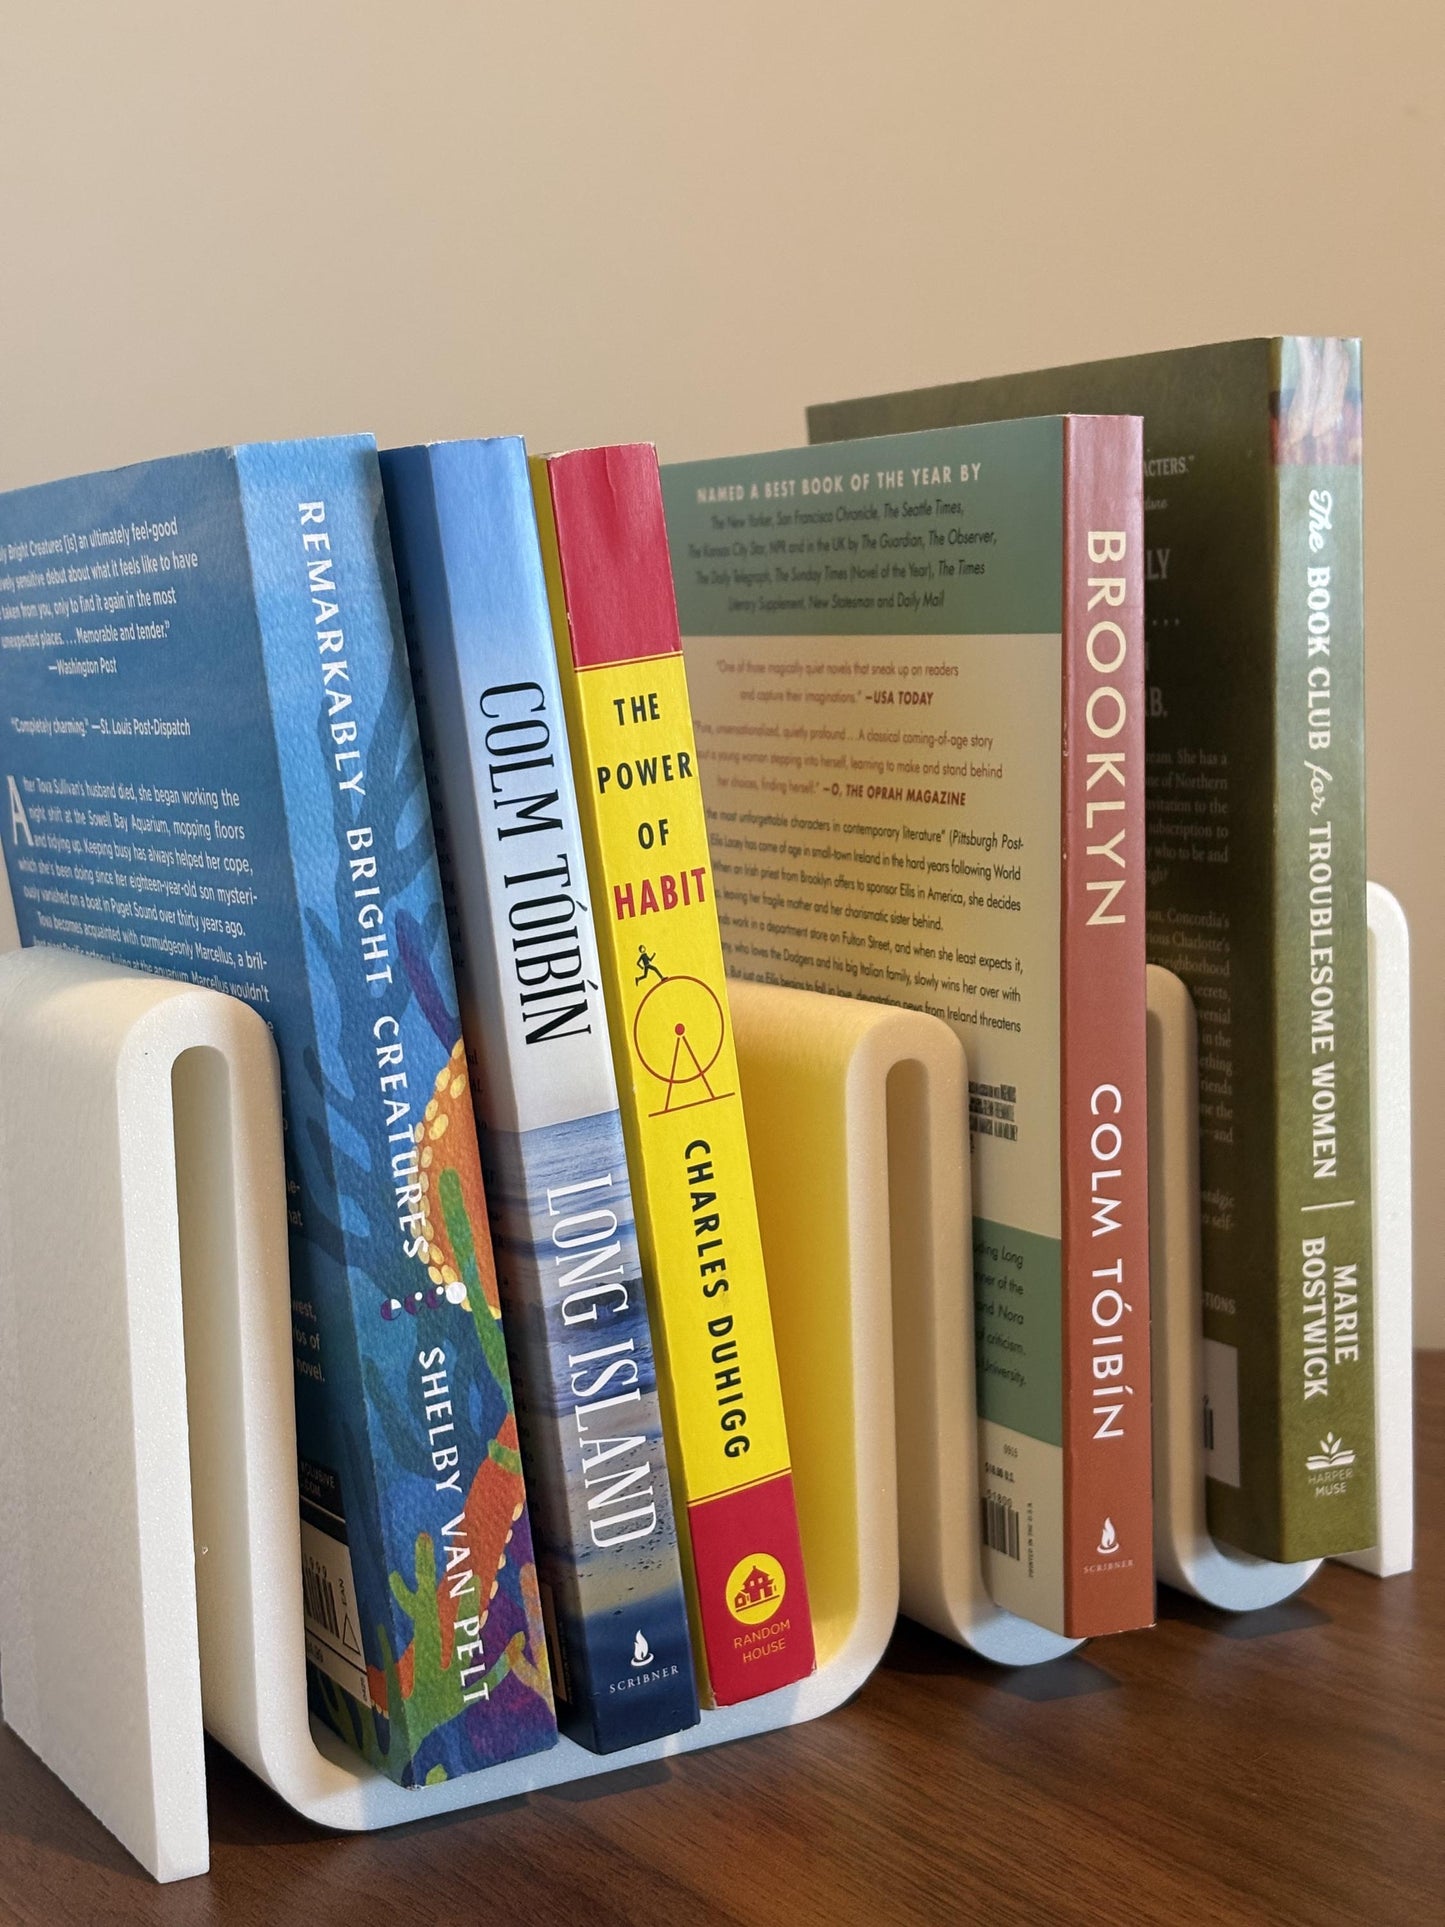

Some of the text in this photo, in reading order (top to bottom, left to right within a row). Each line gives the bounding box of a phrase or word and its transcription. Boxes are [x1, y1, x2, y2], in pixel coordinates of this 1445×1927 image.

[697, 463, 981, 503] NAMED A BEST BOOK OF THE YEAR BY
[884, 499, 964, 518] The Seattle Times,
[30, 516, 178, 556] Creatures [is] an ultimately feel-good
[862, 528, 997, 551] The Guardian, The Observer,
[68, 550, 198, 582] about what it feels like to have
[938, 560, 985, 576] The Times
[79, 584, 177, 613] find it again in the most
[897, 589, 944, 611] Daily Mail
[76, 620, 171, 644] Memorable and tender.”
[100, 656, 117, 674] Post
[925, 663, 959, 677] readers
[613, 693, 660, 725] THE
[897, 691, 934, 706] TODAY
[113, 719, 132, 736] Louis
[133, 719, 191, 738] Post-Dispatch
[902, 731, 993, 751] coming-of-age story
[1085, 531, 1127, 926] BROOKLYN
[597, 751, 693, 793] POWER
[923, 761, 1003, 778] and stand behind
[85, 781, 240, 809] husband died, she began working the
[846, 785, 863, 798] THE
[867, 787, 902, 802] OPRAH
[906, 789, 966, 806] MAGAZINE
[114, 812, 245, 841] Bay Aquarium, mopping floors
[638, 819, 669, 849] OF
[843, 823, 1023, 852] contemporary literature” (Pittsburgh Post-
[1304, 490, 1337, 1180] The BOOK CLUB for TROUBLESOME WOMEN
[116, 844, 253, 876] busy has always helped her cope,
[479, 681, 598, 1045] COLM TÓIBÍN
[853, 849, 1020, 882] Ireland following World
[116, 871, 257, 906] her eighteen-year-old son mysteri-
[299, 501, 429, 1258] REMARKABLY BRIGHT CREATURES
[613, 867, 706, 920] HABIT
[928, 886, 1020, 912] America, she decides
[111, 898, 245, 938] Puget Sound over thirty years ago.
[891, 913, 943, 932] sister behind.
[123, 931, 267, 970] with curmudgeonly Marcellus, a bril-
[842, 932, 1023, 974] Fulton Street, least expects it,
[886, 966, 1020, 1001] family, slowly wins over with
[947, 1002, 1020, 1032] Ireland threatens
[1001, 1245, 1024, 1270] Long
[1090, 1084, 1133, 1440] COLM TÓIBÍN
[684, 1138, 751, 1460] CHARLES DUHIGG
[998, 1304, 1024, 1325] Nora
[1302, 1236, 1328, 1400] BOSTWICK
[1333, 1264, 1359, 1366] MARIE
[546, 1172, 657, 1549] LONG ISLAND
[1308, 1469, 1353, 1484] HARPER
[1315, 1482, 1347, 1497] MUSE
[418, 1346, 489, 1702] SHELBY VAN PELT
[1083, 1560, 1134, 1575] SCRIBNER
[734, 1619, 791, 1649] RANDOM
[742, 1639, 787, 1665] HOUSE
[609, 1664, 680, 1694] SCRIBNER
